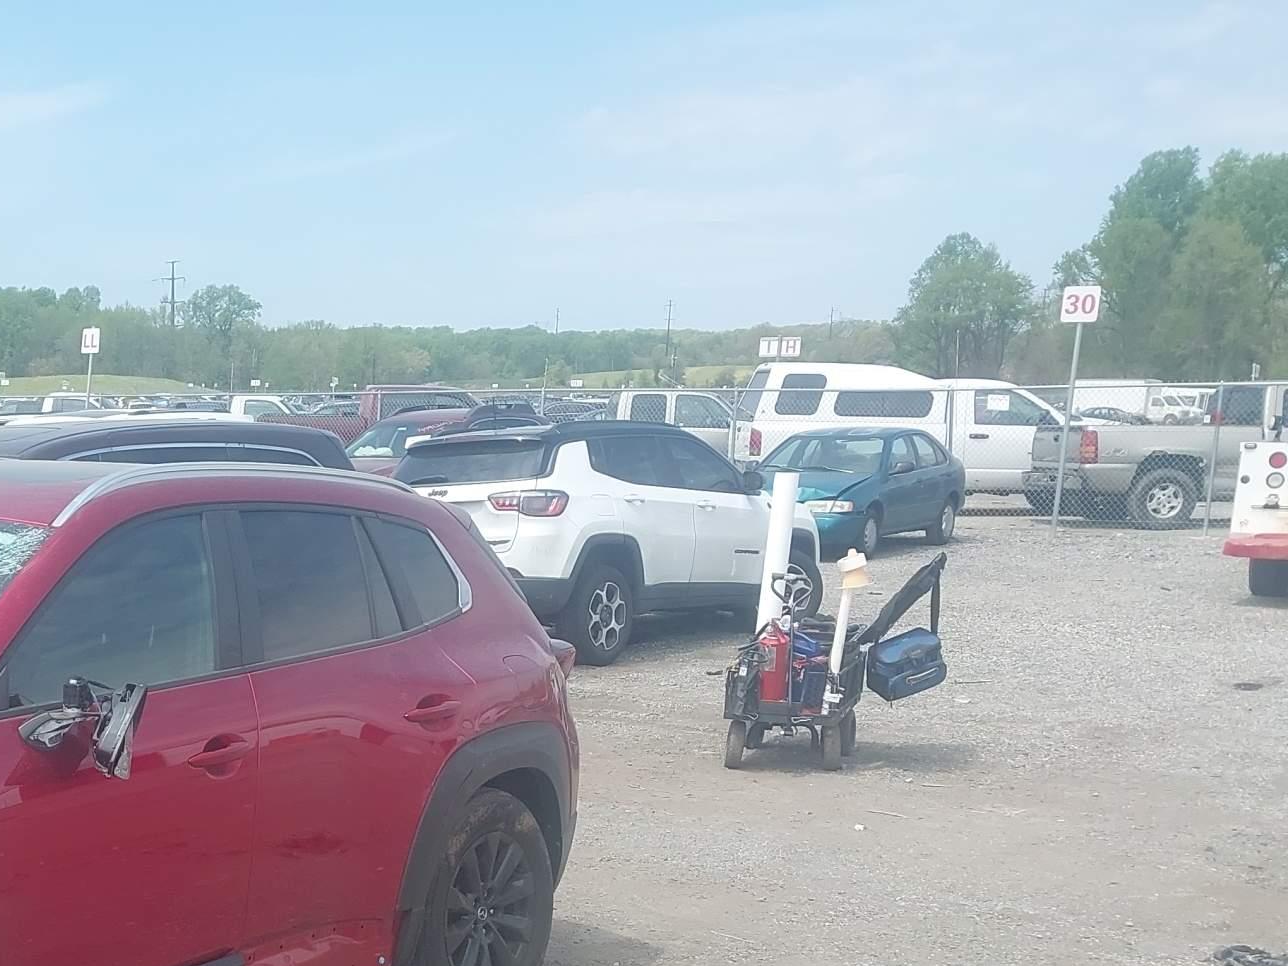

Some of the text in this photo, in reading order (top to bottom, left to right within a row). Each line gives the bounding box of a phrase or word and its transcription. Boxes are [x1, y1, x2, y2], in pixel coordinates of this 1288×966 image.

[1064, 294, 1097, 315] 30
[83, 333, 98, 349] LL
[785, 339, 797, 354] H
